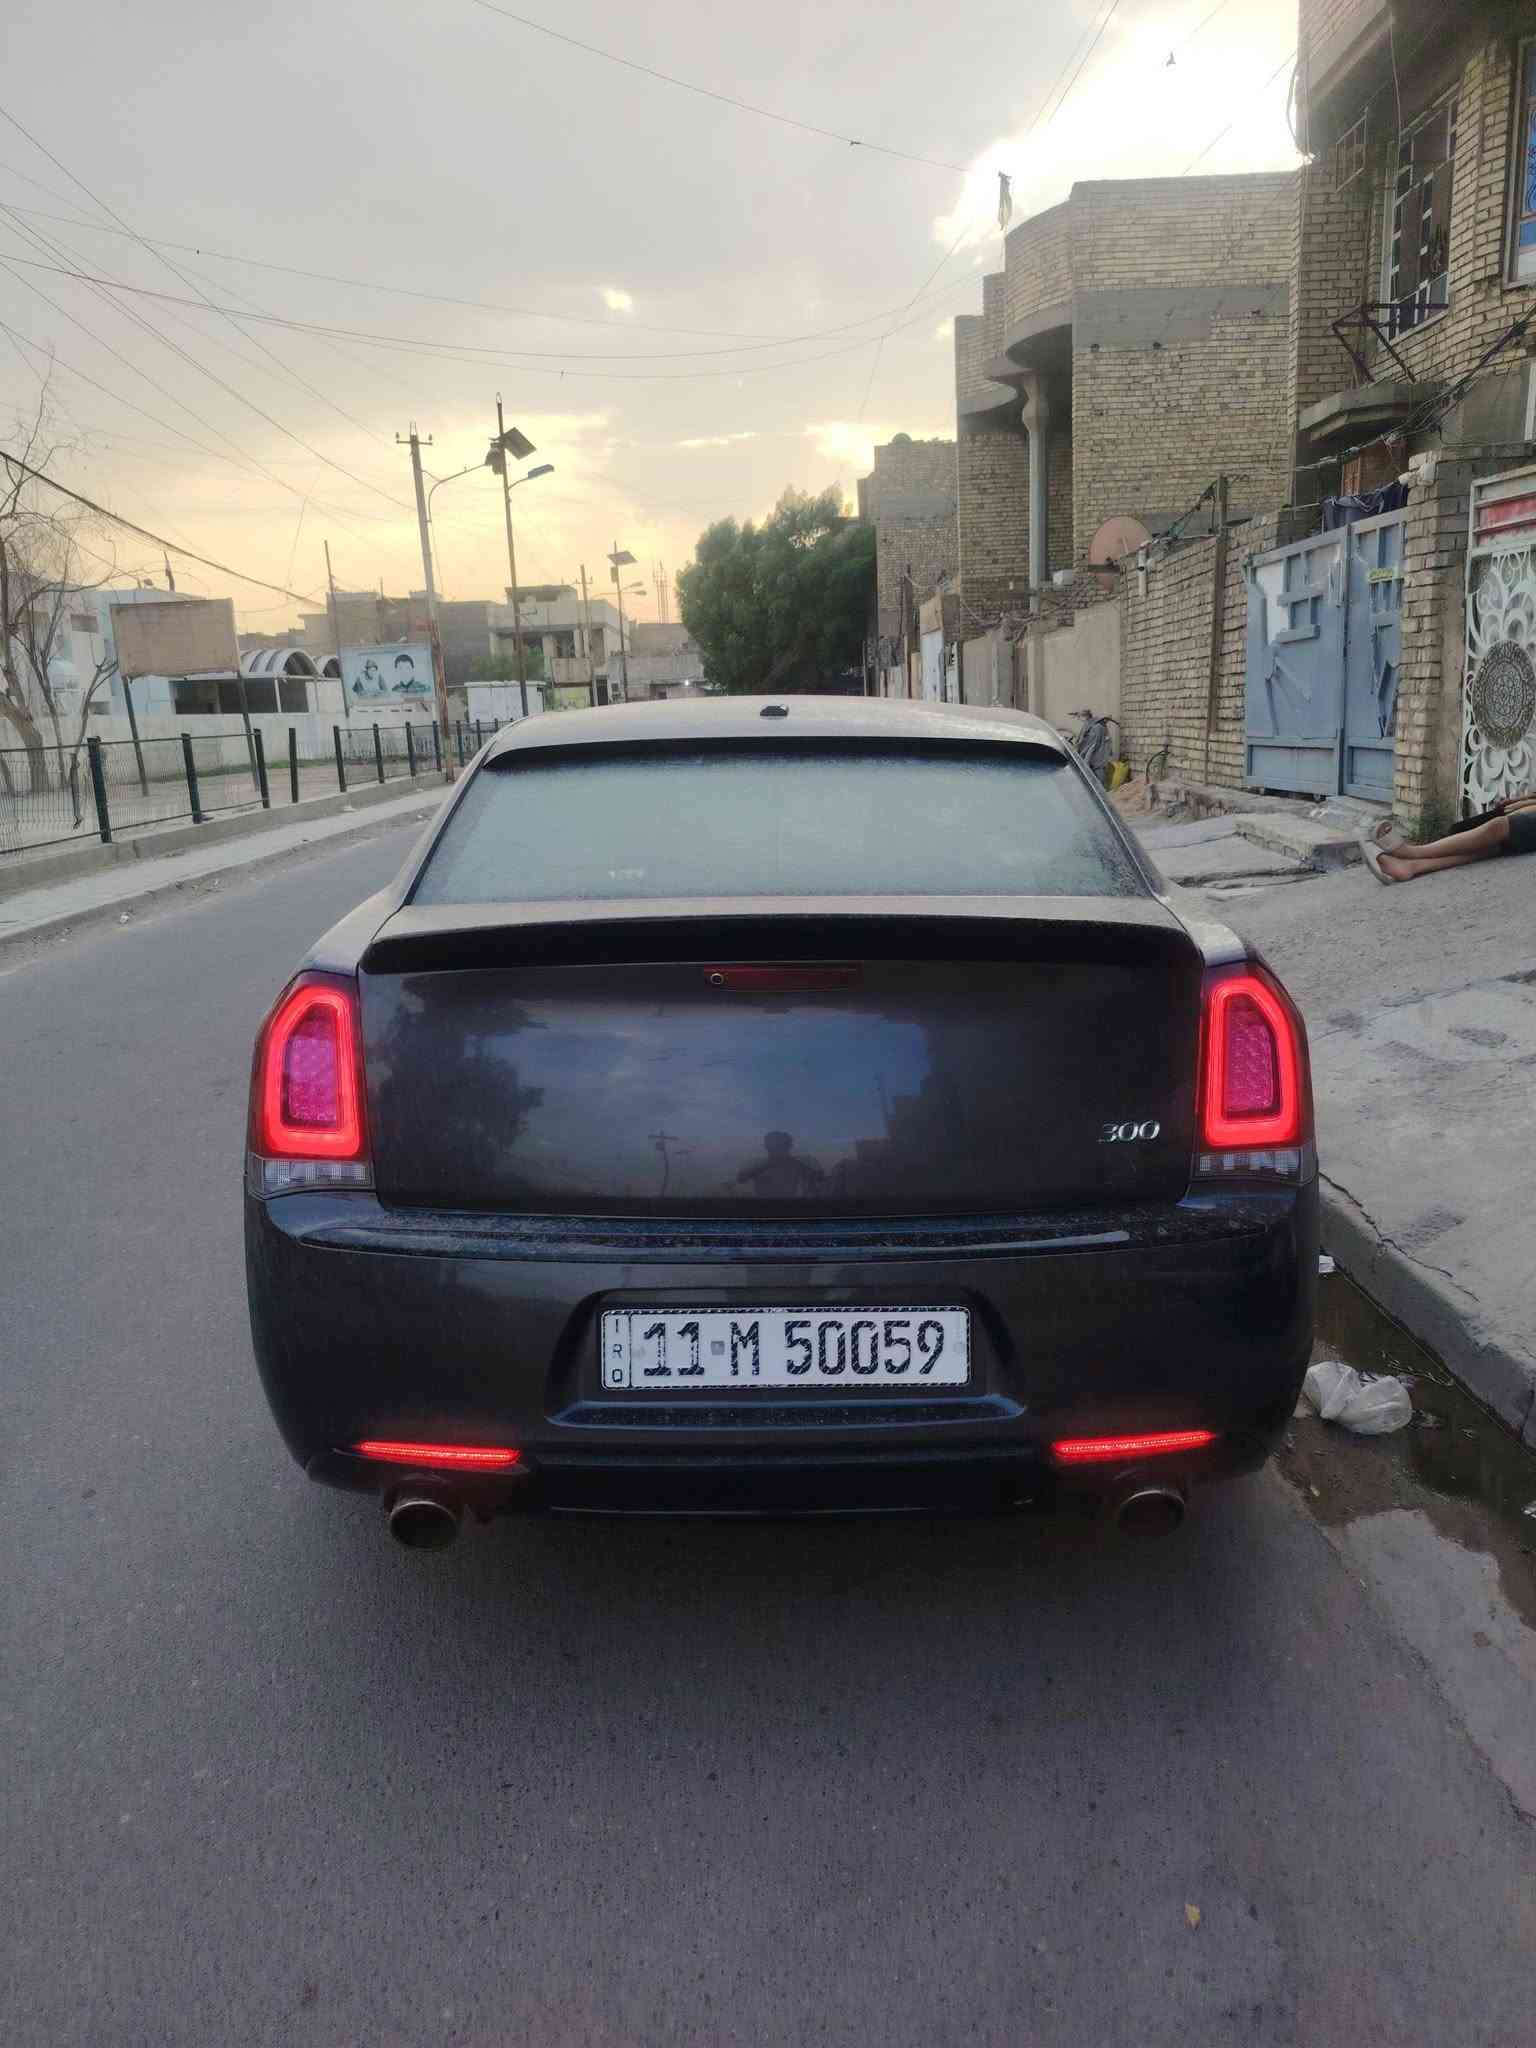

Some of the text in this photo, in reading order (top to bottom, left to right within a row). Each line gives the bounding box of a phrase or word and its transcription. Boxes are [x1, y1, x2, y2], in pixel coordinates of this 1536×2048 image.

[1097, 1120, 1161, 1142] 300
[643, 1319, 946, 1377] 11 M 50059
